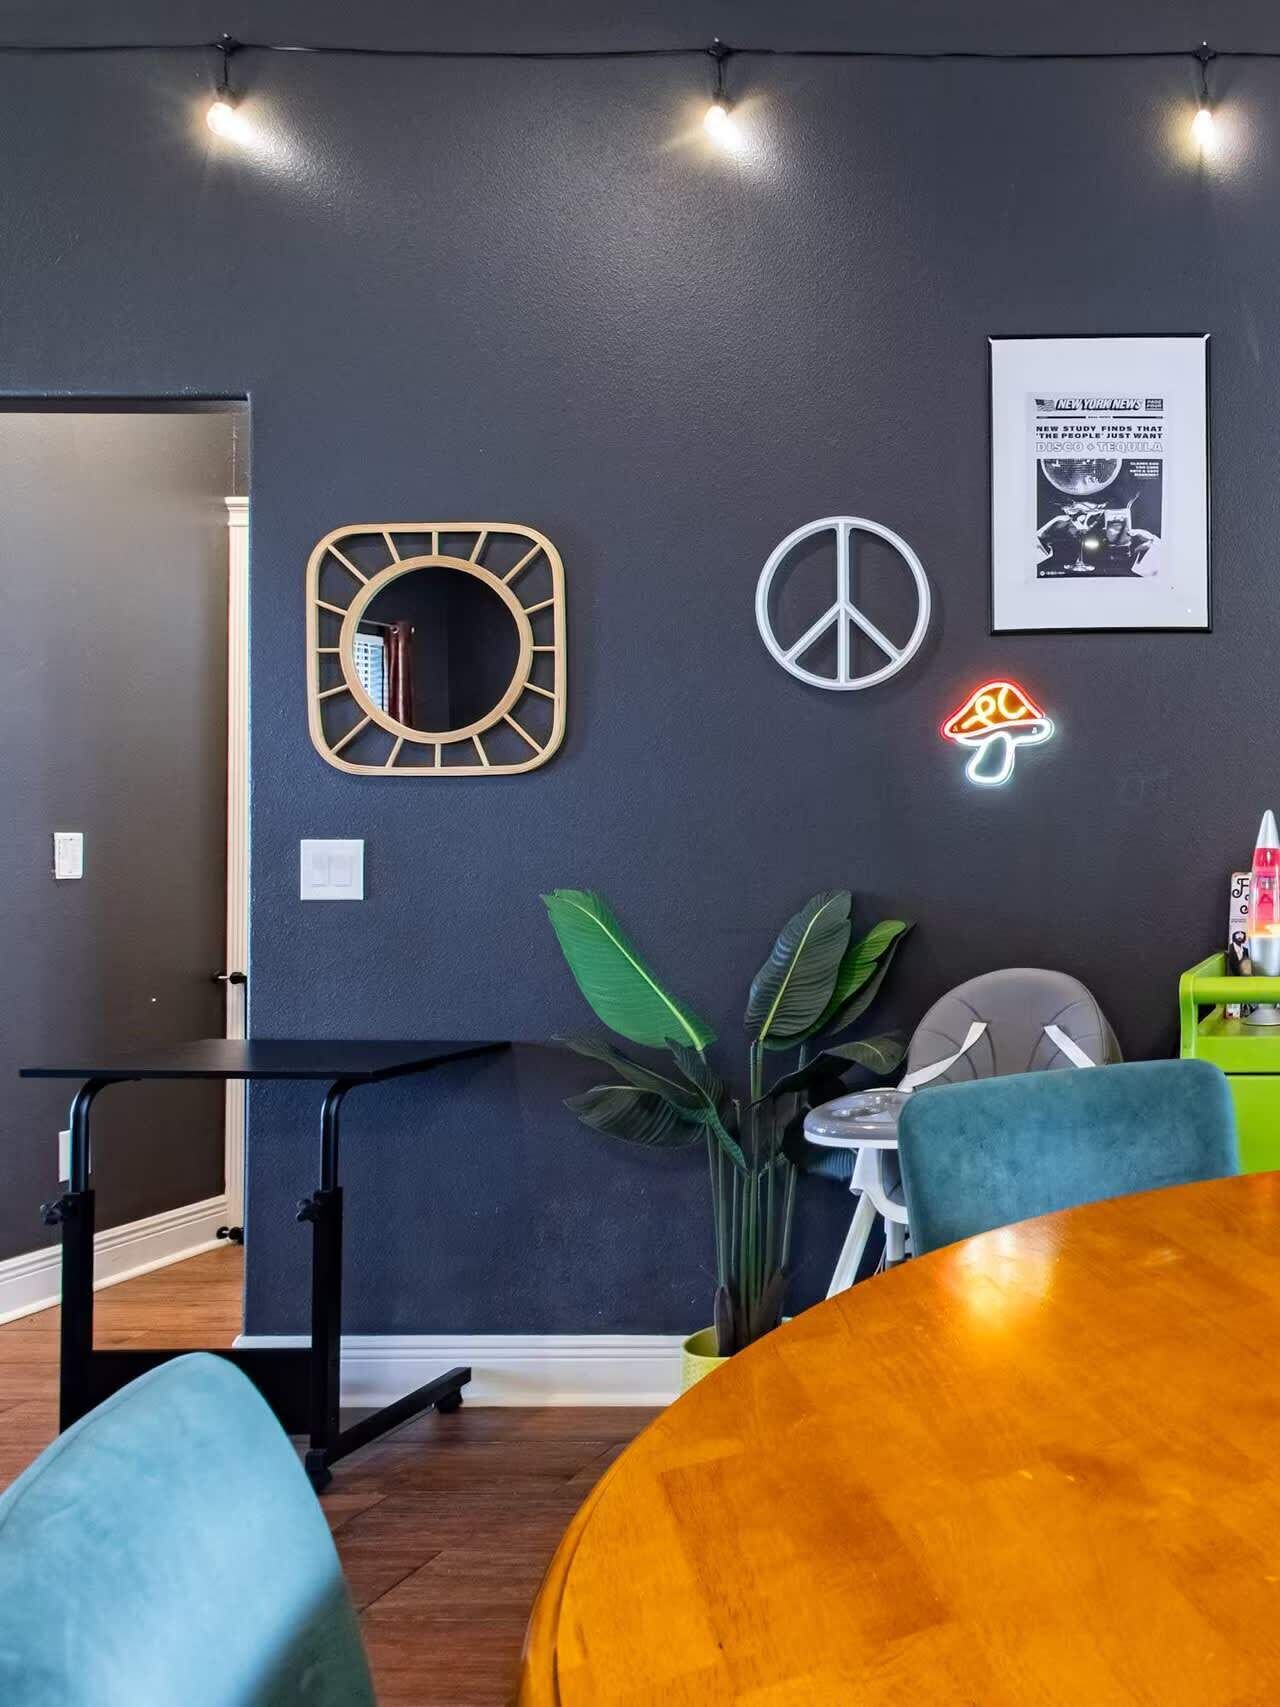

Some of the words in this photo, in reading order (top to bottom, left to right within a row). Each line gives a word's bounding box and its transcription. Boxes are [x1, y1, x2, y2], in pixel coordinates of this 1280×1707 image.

[1056, 399, 1083, 411] NEW
[1082, 399, 1112, 411] YORK
[1111, 399, 1142, 411] NEWS
[1036, 441, 1084, 453] DISCO
[1096, 441, 1163, 454] TEQUILA
